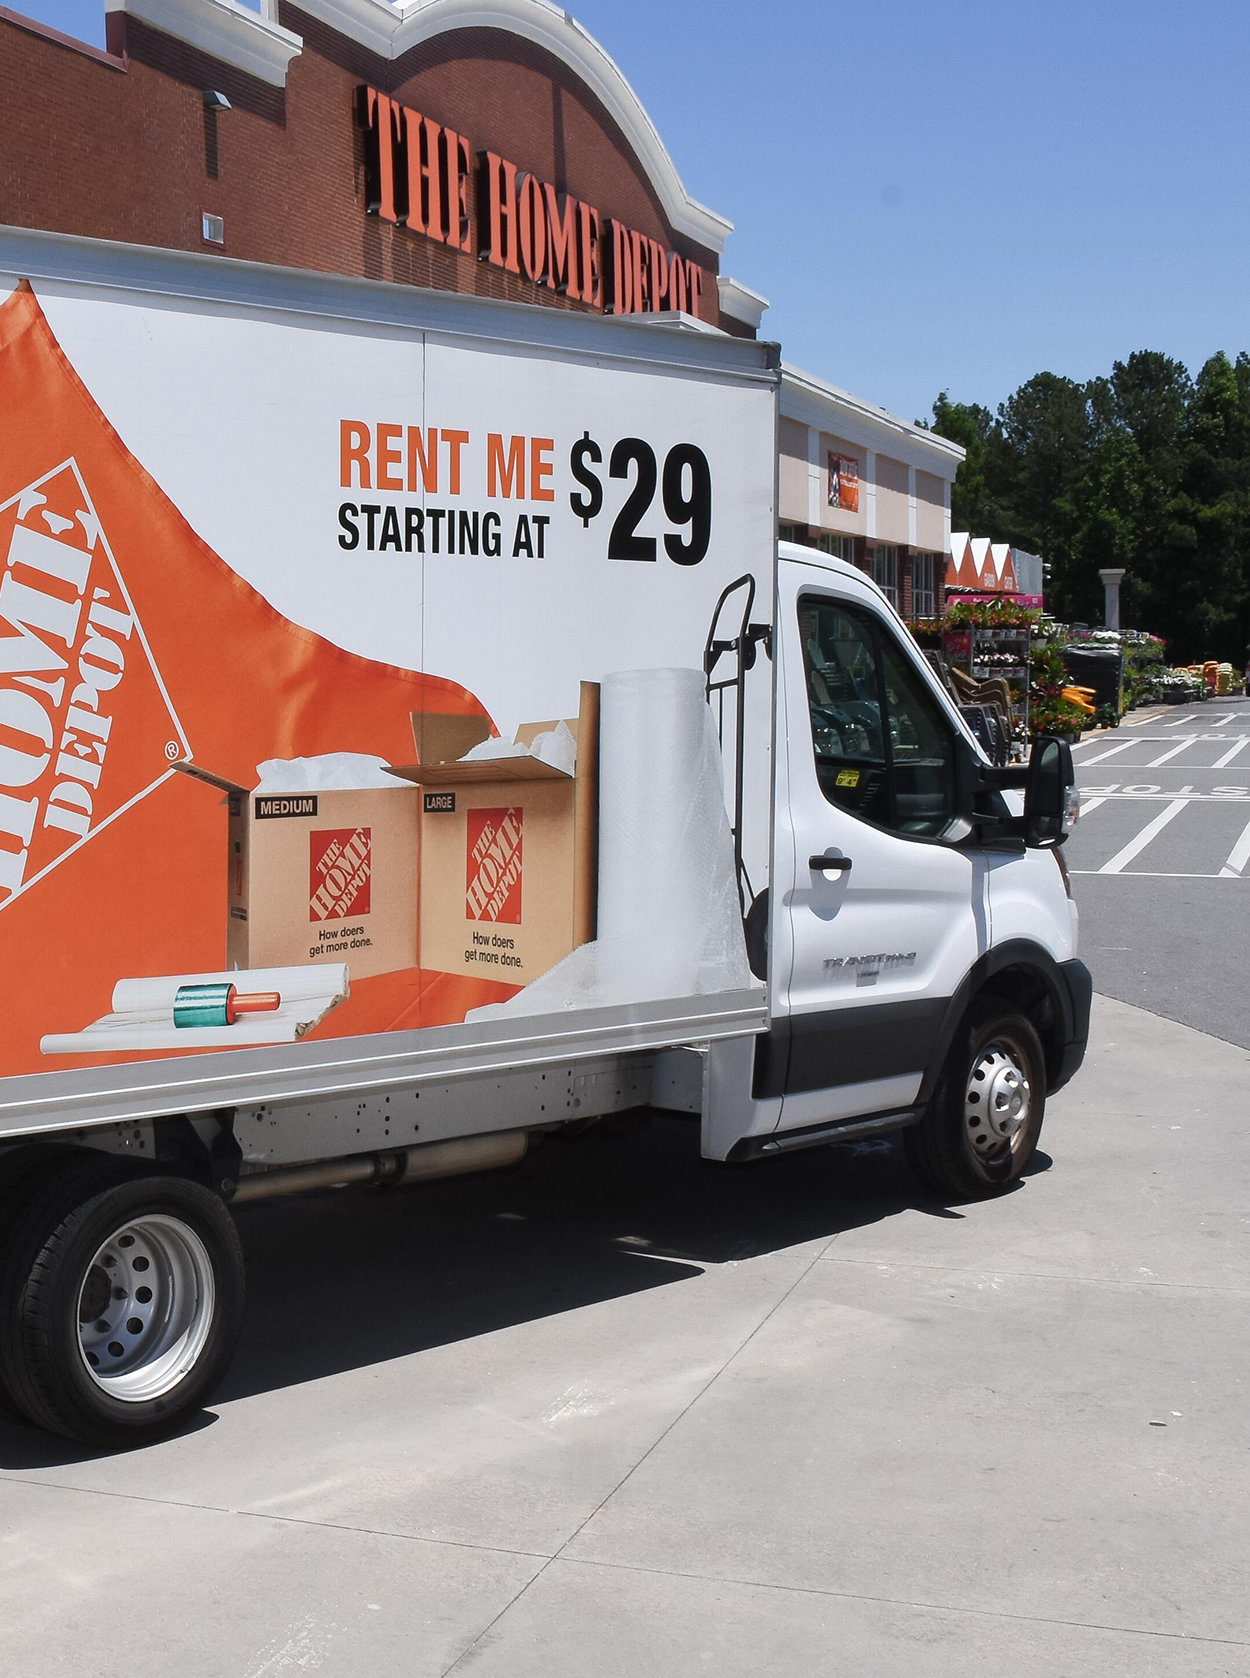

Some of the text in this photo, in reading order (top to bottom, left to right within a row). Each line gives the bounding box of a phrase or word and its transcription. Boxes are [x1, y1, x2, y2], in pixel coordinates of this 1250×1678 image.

[362, 85, 702, 317] THE HOME DEPOT
[339, 419, 555, 502] RENT ME
[569, 431, 712, 566] $29
[337, 502, 550, 559] STARTING AT
[43, 586, 136, 837] DEPOT
[260, 799, 313, 815] MEDIUM
[426, 796, 452, 809] LARGE
[1077, 784, 1249, 796] STOP
[316, 839, 342, 876] THE
[466, 807, 523, 920] HOME
[472, 820, 495, 865] THE
[310, 828, 371, 920] HOME
[334, 860, 371, 918] DEPOT
[487, 851, 522, 922] DEPOT
[309, 937, 373, 958] get more done.
[318, 926, 364, 941] How doers
[464, 949, 523, 968] get more done.
[473, 931, 515, 949] How doers
